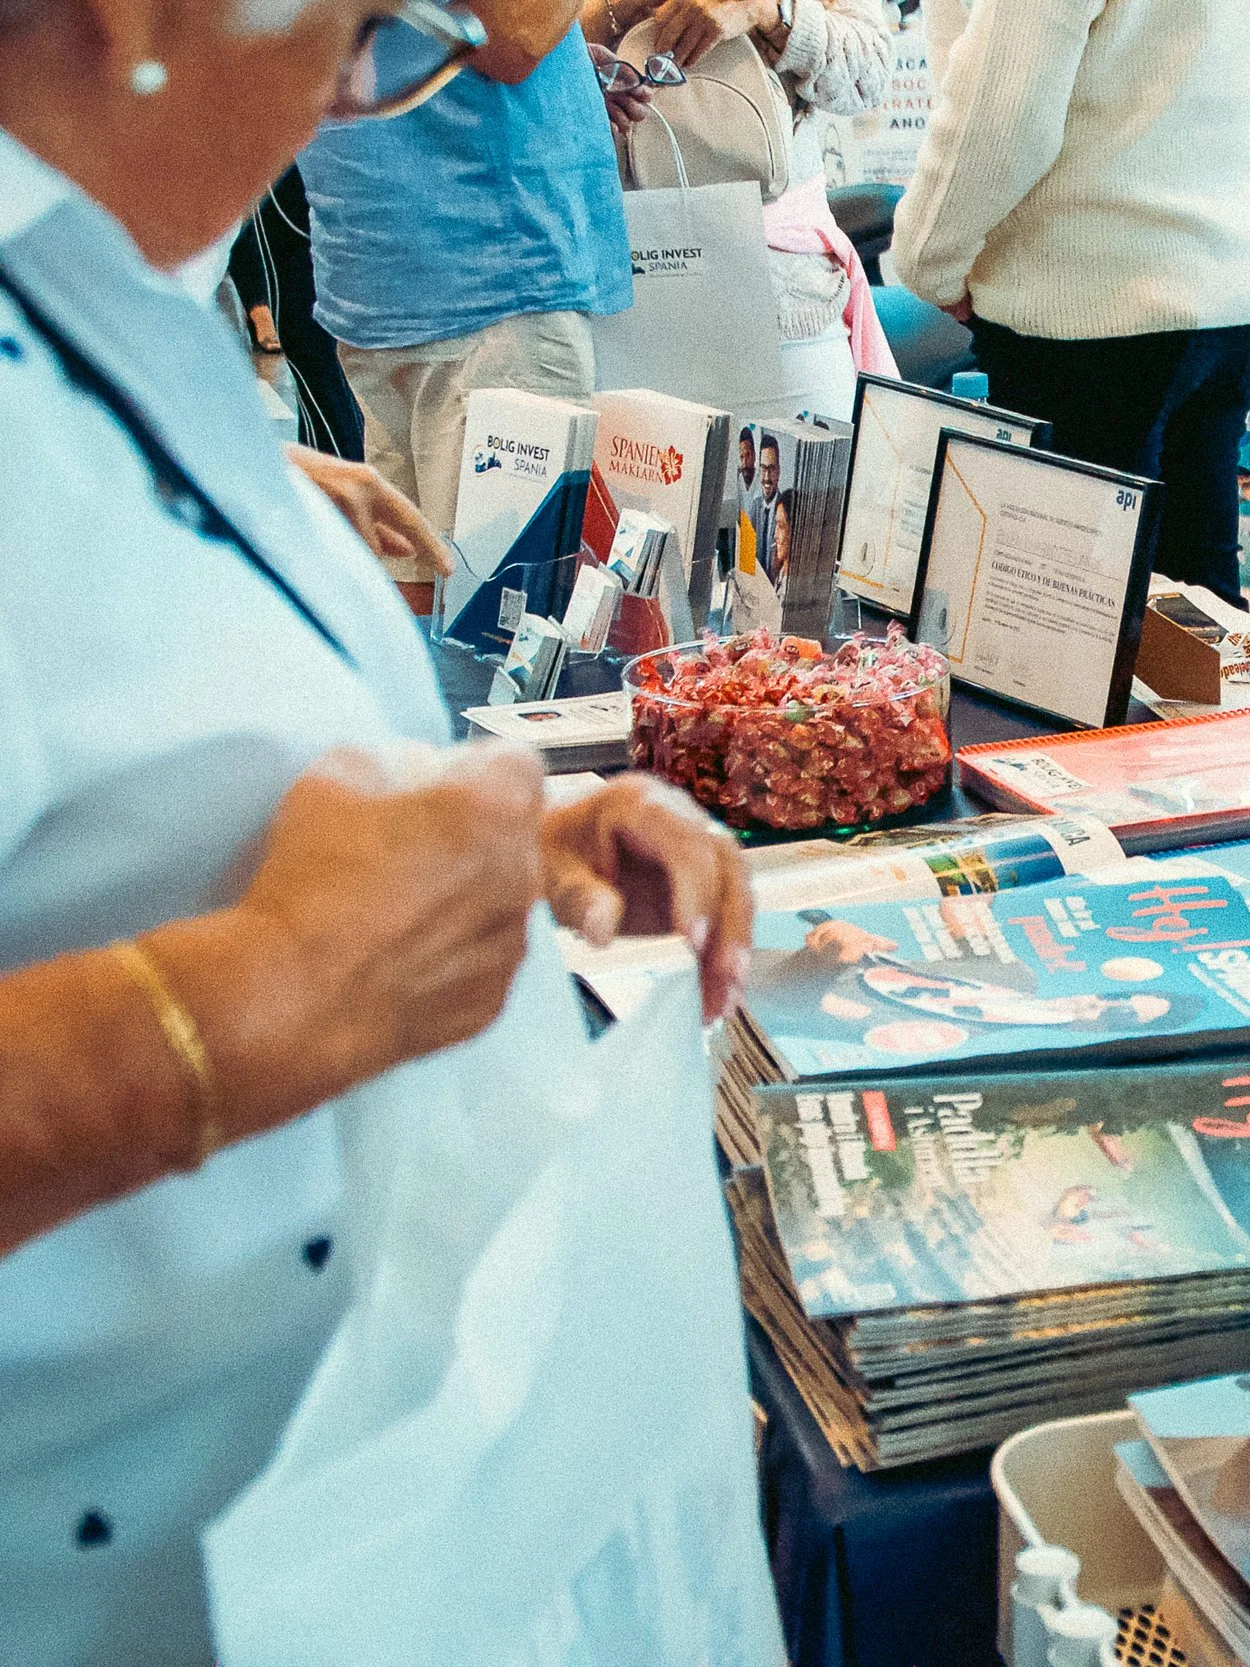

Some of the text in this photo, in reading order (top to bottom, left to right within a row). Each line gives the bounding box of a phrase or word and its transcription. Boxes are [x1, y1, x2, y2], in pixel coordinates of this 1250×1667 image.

[631, 247, 702, 261] OLIG INVEST
[487, 434, 550, 462] BOLIG INVEST
[513, 457, 548, 479] SPANIA
